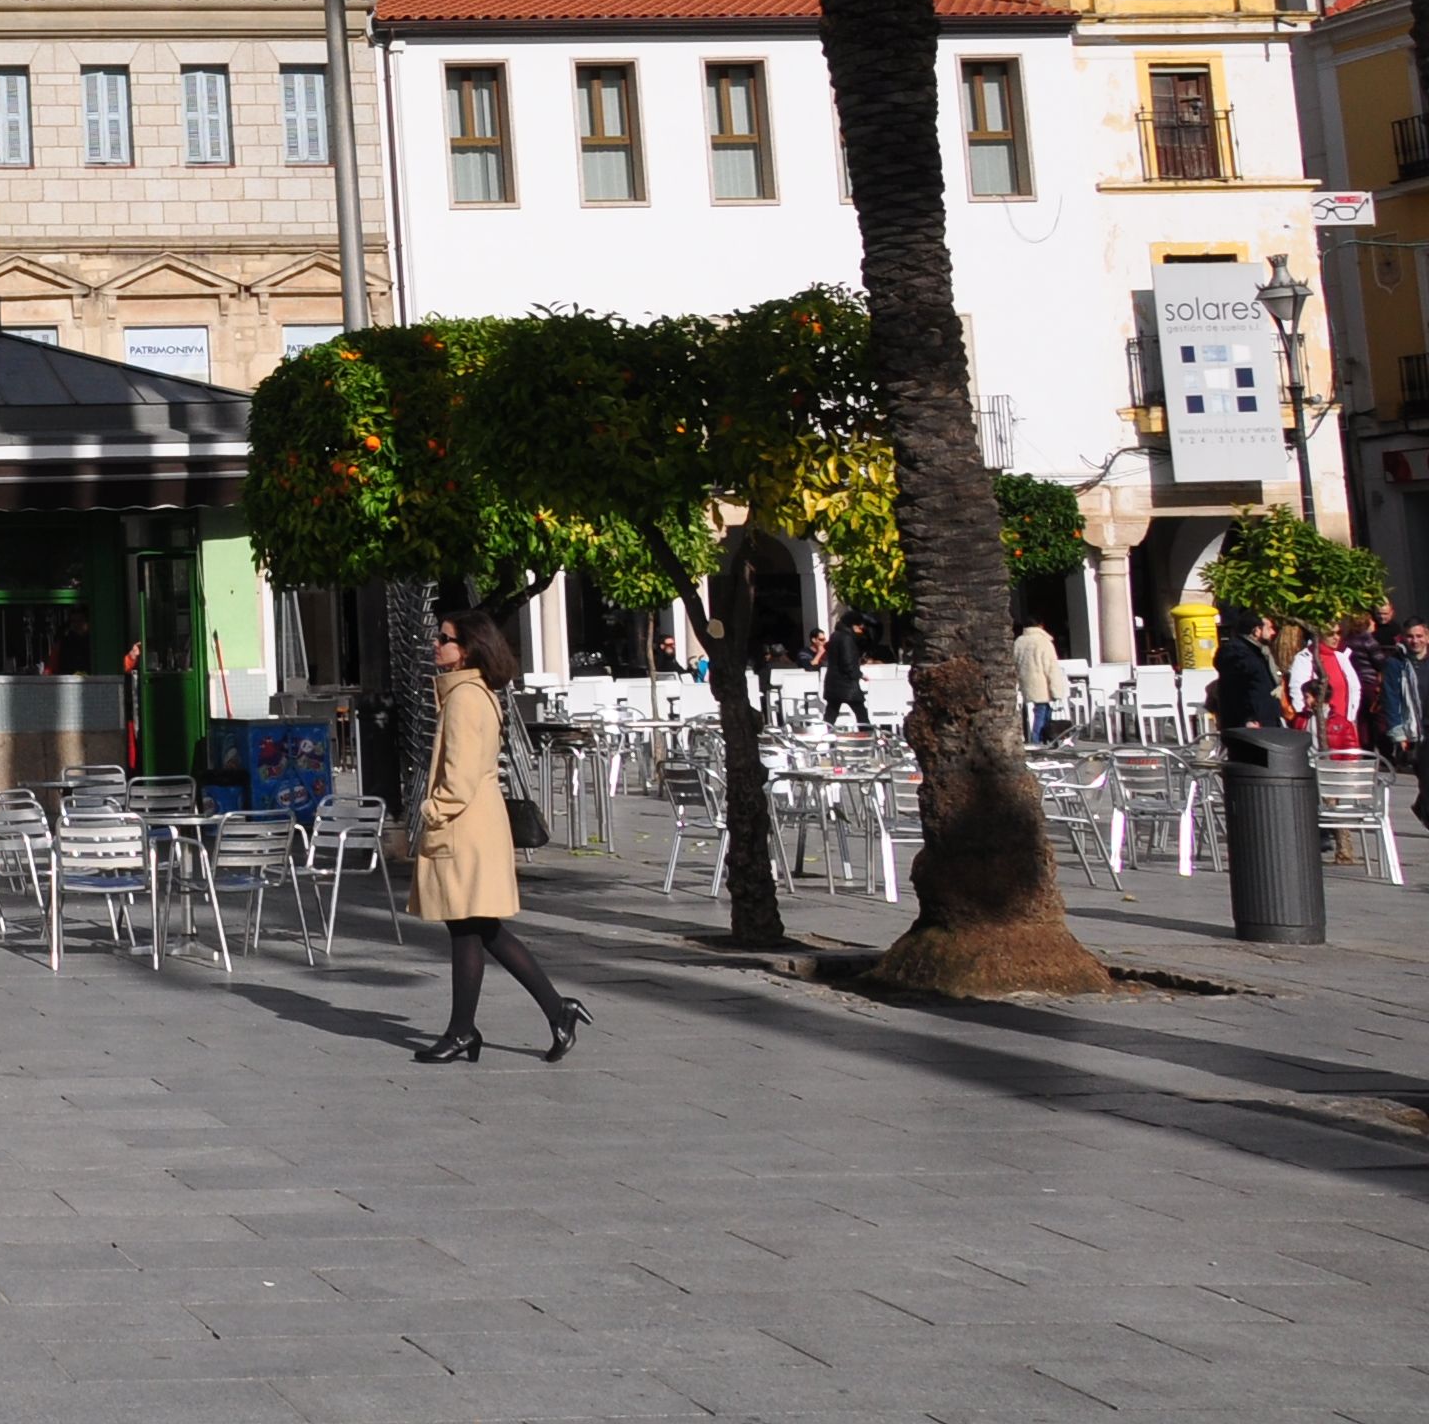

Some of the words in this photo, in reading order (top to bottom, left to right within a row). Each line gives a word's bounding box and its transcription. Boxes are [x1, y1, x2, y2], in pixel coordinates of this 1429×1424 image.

[1164, 297, 1261, 322] solares
[1205, 323, 1219, 332] de
[130, 345, 205, 355] PATRIMONIVM
